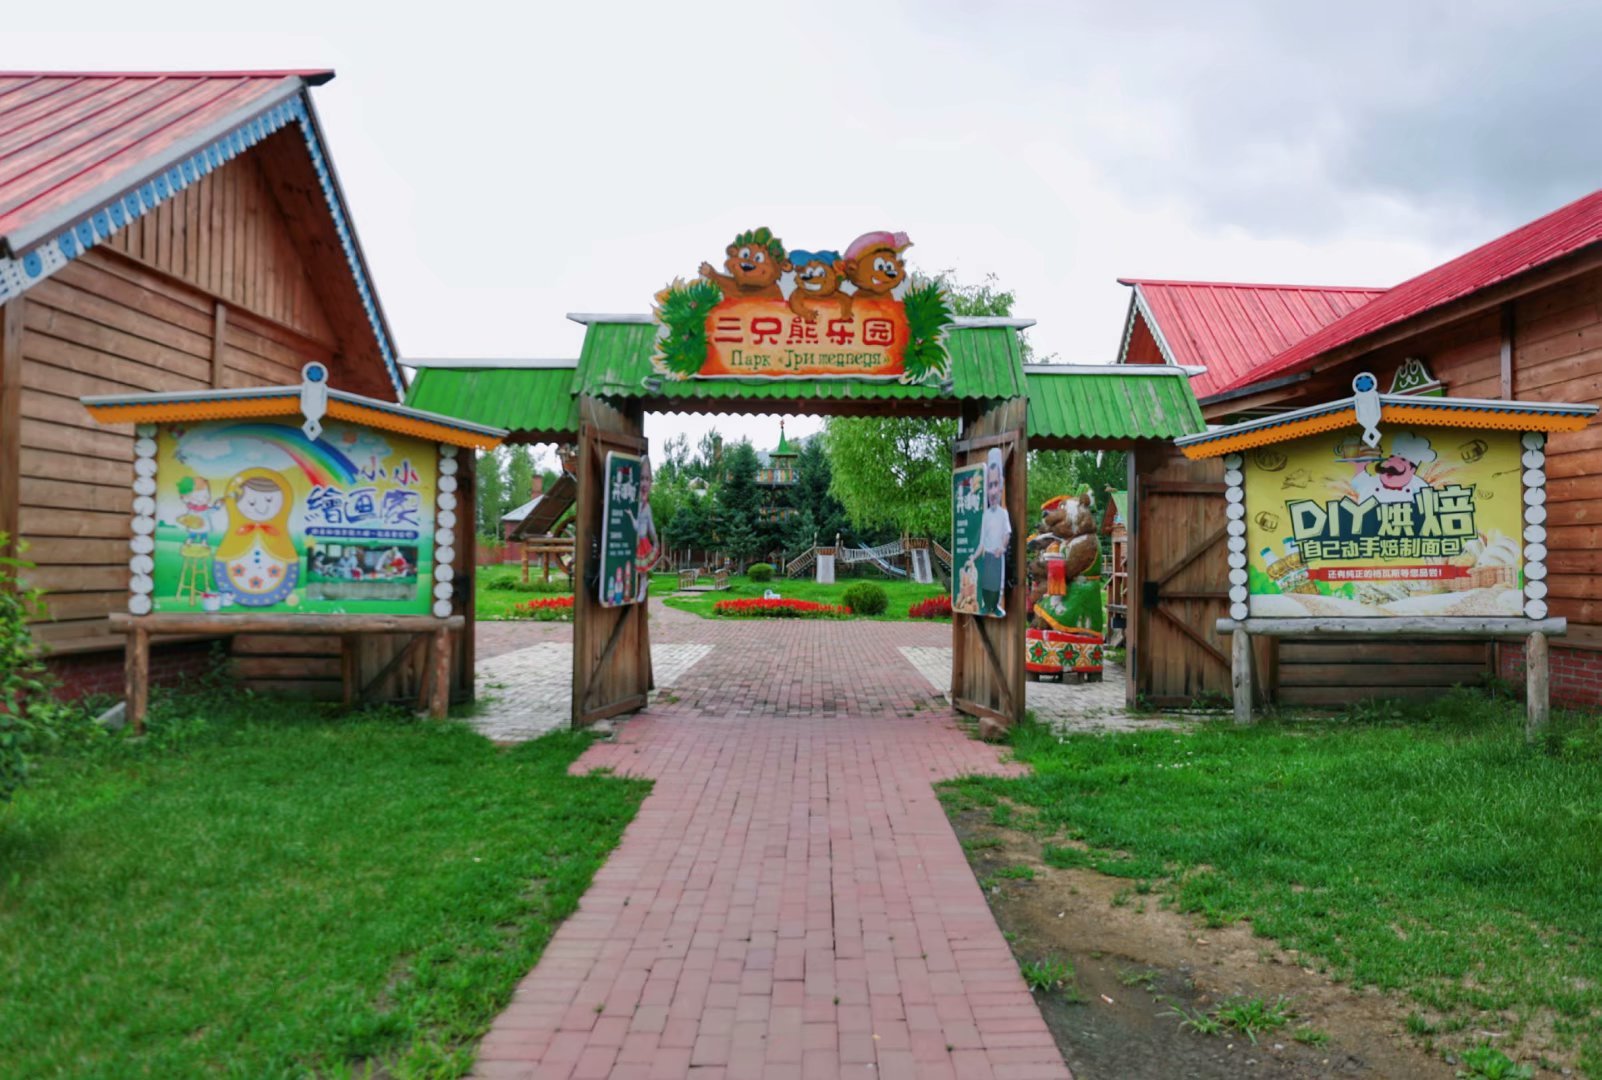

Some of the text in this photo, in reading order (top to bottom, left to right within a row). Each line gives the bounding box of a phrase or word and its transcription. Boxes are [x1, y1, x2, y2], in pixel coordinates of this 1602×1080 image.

[714, 317, 895, 346] 三只熊乐园
[731, 349, 770, 370] Парк
[361, 456, 419, 485] 小小
[1289, 485, 1475, 539] DIY烘焙
[1303, 536, 1460, 559] 自己动手焙制面包
